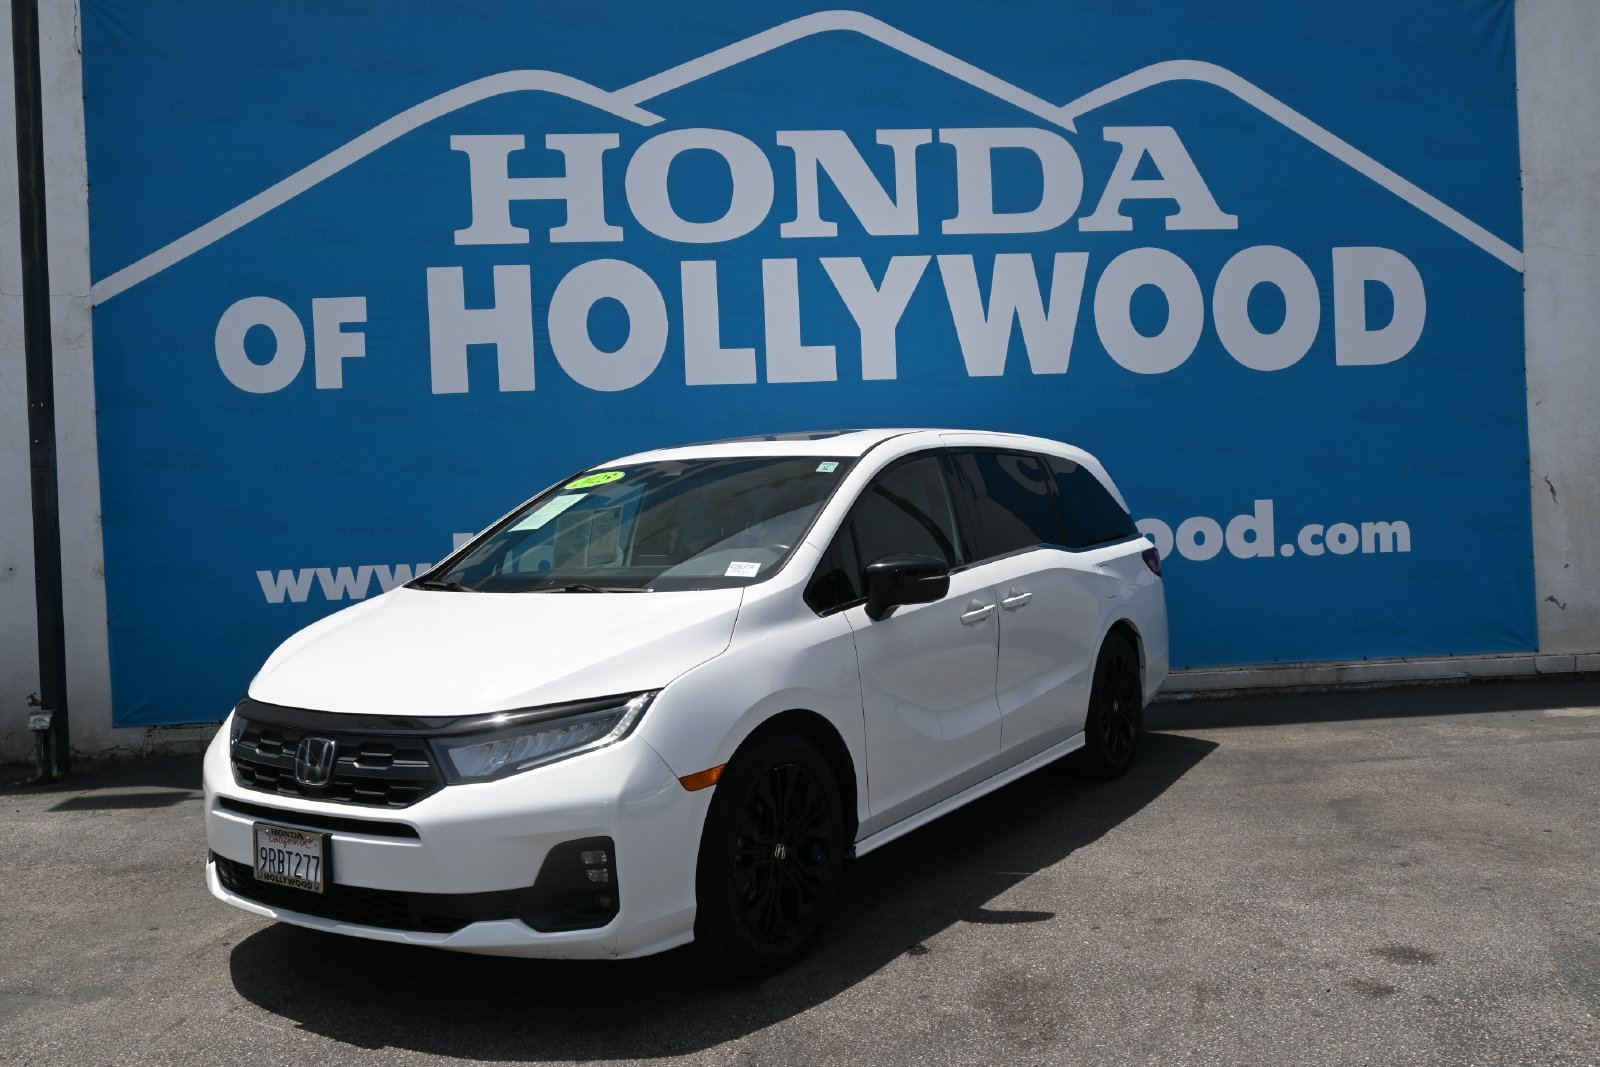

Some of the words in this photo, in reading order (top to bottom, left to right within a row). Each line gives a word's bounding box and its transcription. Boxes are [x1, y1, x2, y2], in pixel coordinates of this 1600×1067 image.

[451, 126, 1238, 245] HONDA
[215, 296, 367, 394] OF
[427, 246, 1426, 395] HOLLYWOOD
[269, 828, 304, 840] HONDA
[259, 846, 320, 882] 9RBT277
[264, 873, 313, 890] HOLLYWOOD
